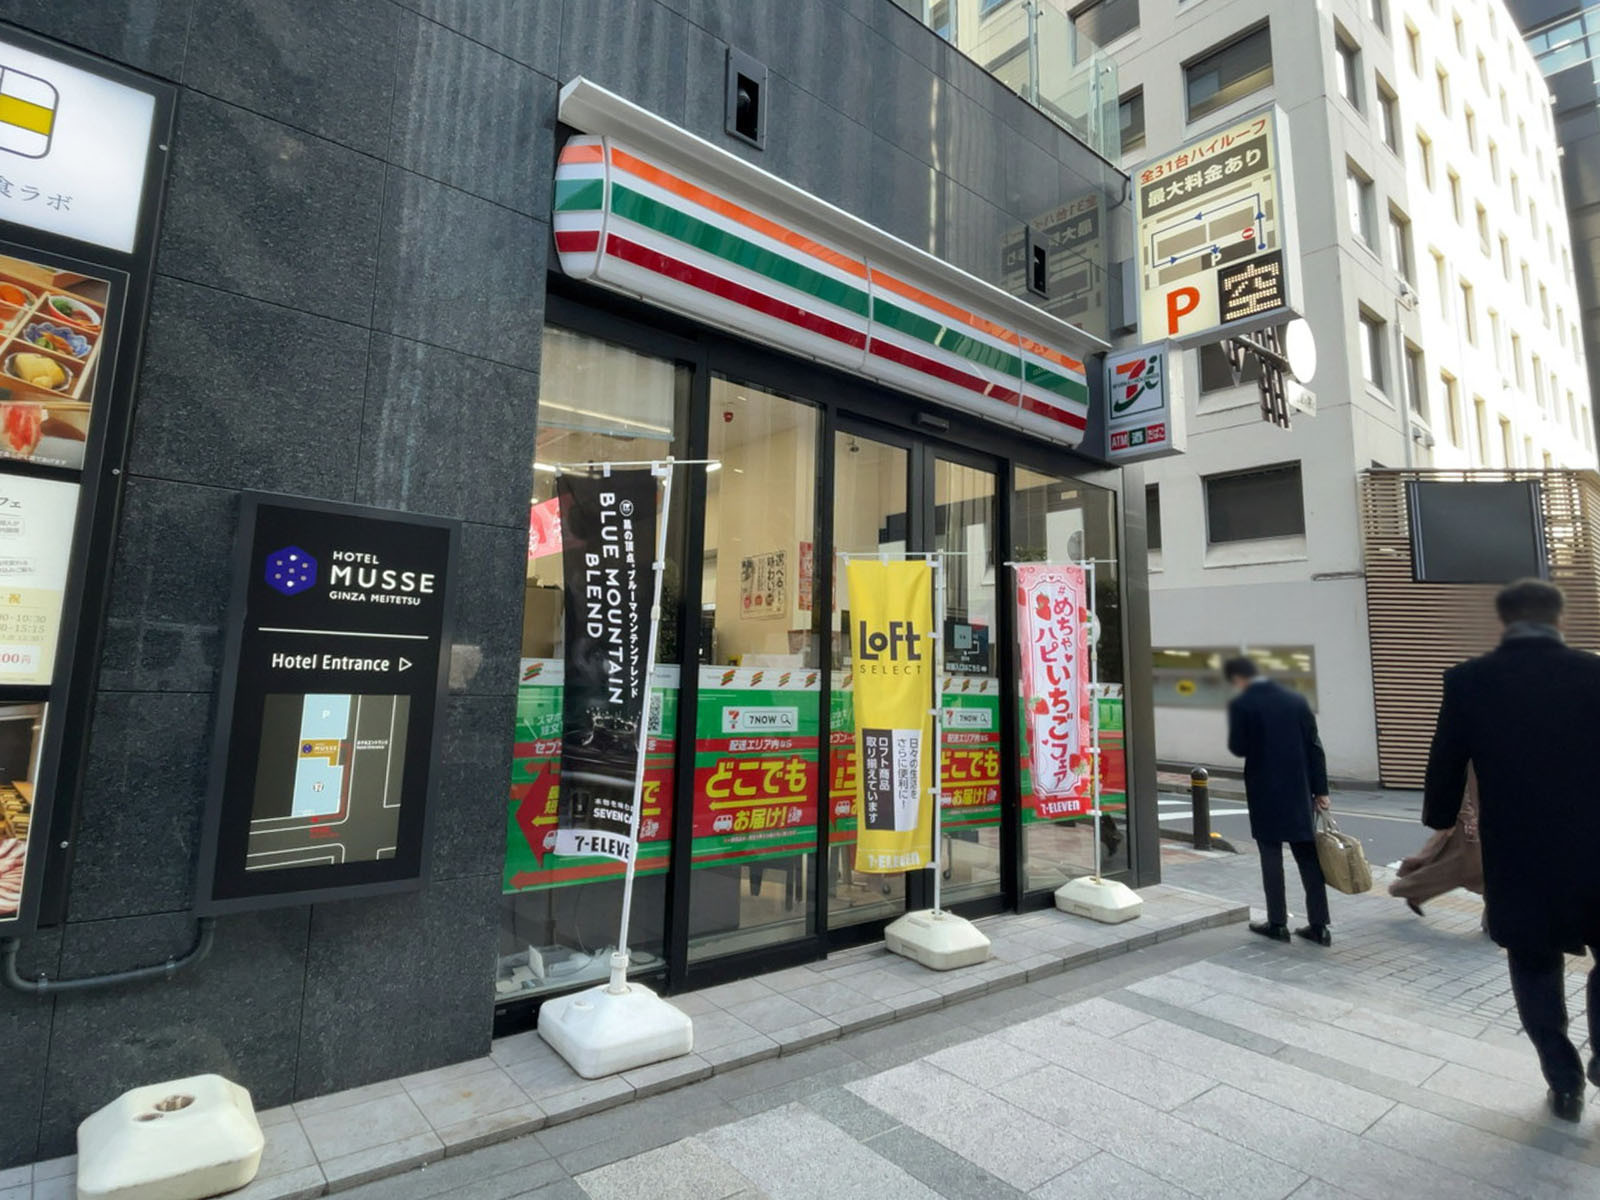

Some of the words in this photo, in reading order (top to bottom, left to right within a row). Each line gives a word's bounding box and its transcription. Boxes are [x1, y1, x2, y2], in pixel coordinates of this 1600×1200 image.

[1140, 118, 1267, 184] 全31台ハイルーフ
[1147, 149, 1262, 208] 最大料金あり
[1211, 253, 1222, 266] P
[1223, 262, 1282, 321] 空
[1166, 286, 1201, 335] P
[600, 492, 619, 559] BLUE
[333, 551, 380, 565] HOTEL
[330, 565, 435, 594] MUSSE
[585, 553, 603, 638] BLEND
[329, 590, 366, 602] GINZA
[370, 593, 421, 606] MEITETSU
[605, 568, 624, 704] MOUNTAIN
[272, 653, 317, 669] Hotel
[322, 655, 390, 671] Entrance
[860, 664, 921, 675] SELECT
[749, 715, 777, 724] 7NOW
[706, 758, 807, 798] どこでも
[866, 736, 878, 824] 取り揃えています
[879, 737, 890, 791] ロフト商品
[952, 789, 987, 806] お届け!
[733, 805, 786, 831] お届け!
[575, 835, 630, 859] 7-ELEVE
